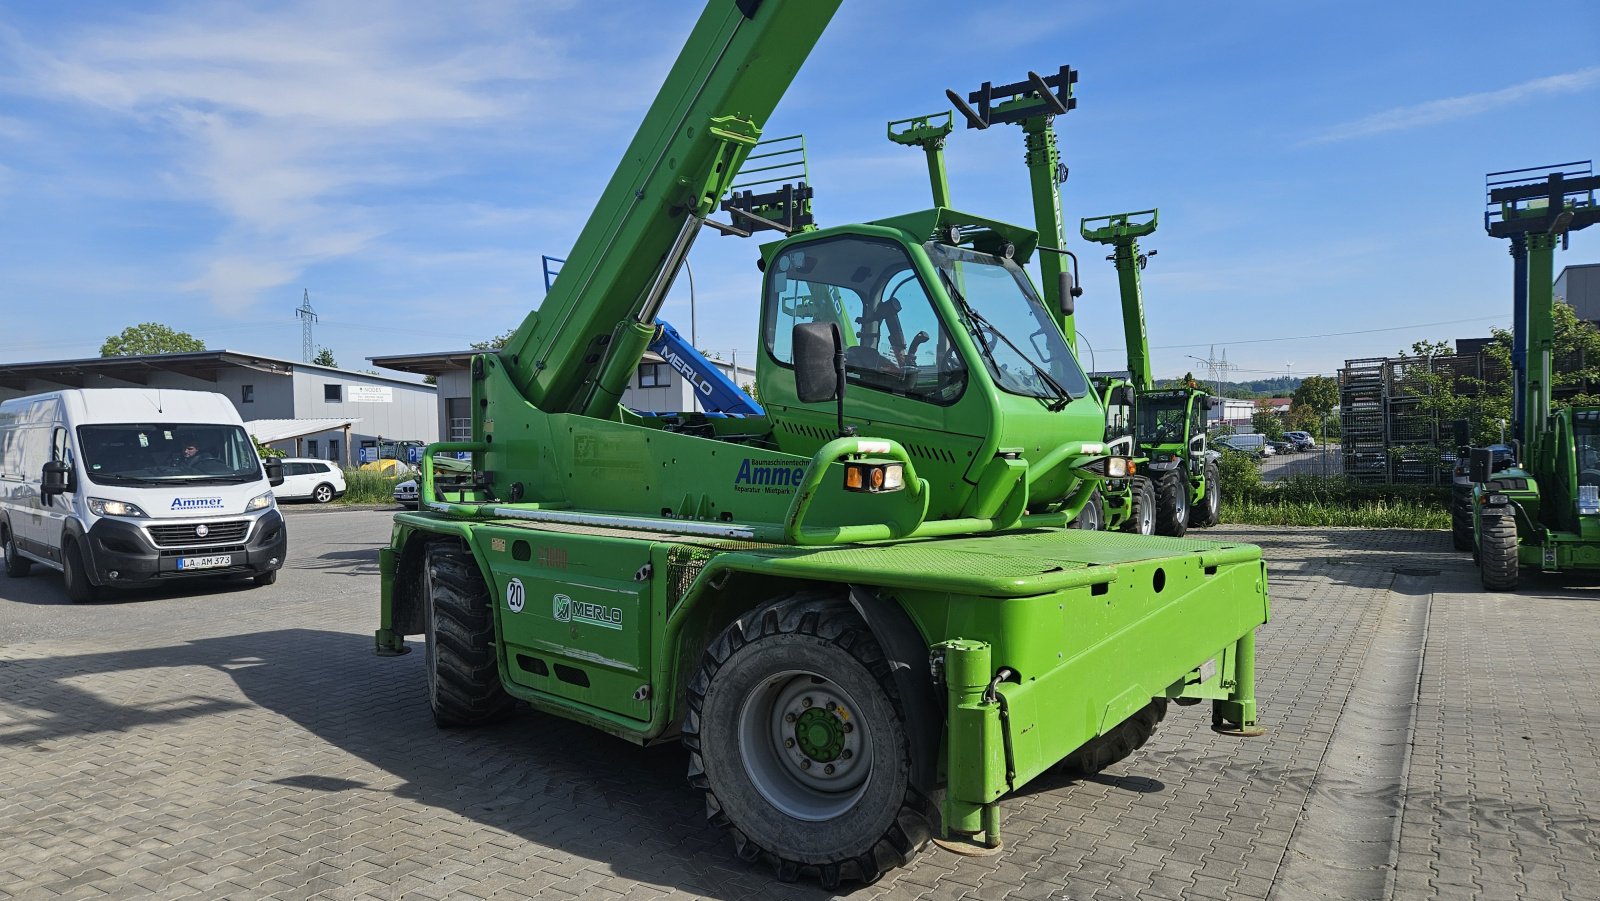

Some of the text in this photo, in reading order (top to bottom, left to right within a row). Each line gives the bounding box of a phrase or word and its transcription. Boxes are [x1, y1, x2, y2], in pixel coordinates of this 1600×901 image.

[661, 345, 713, 396] MERLO
[735, 459, 804, 486] Amme
[735, 486, 760, 494] Reparatur
[765, 487, 790, 495] Mietpark
[172, 498, 222, 507] Ammer
[183, 556, 230, 568] LA AM 373
[509, 583, 522, 608] 20
[572, 601, 623, 624] MERLO
